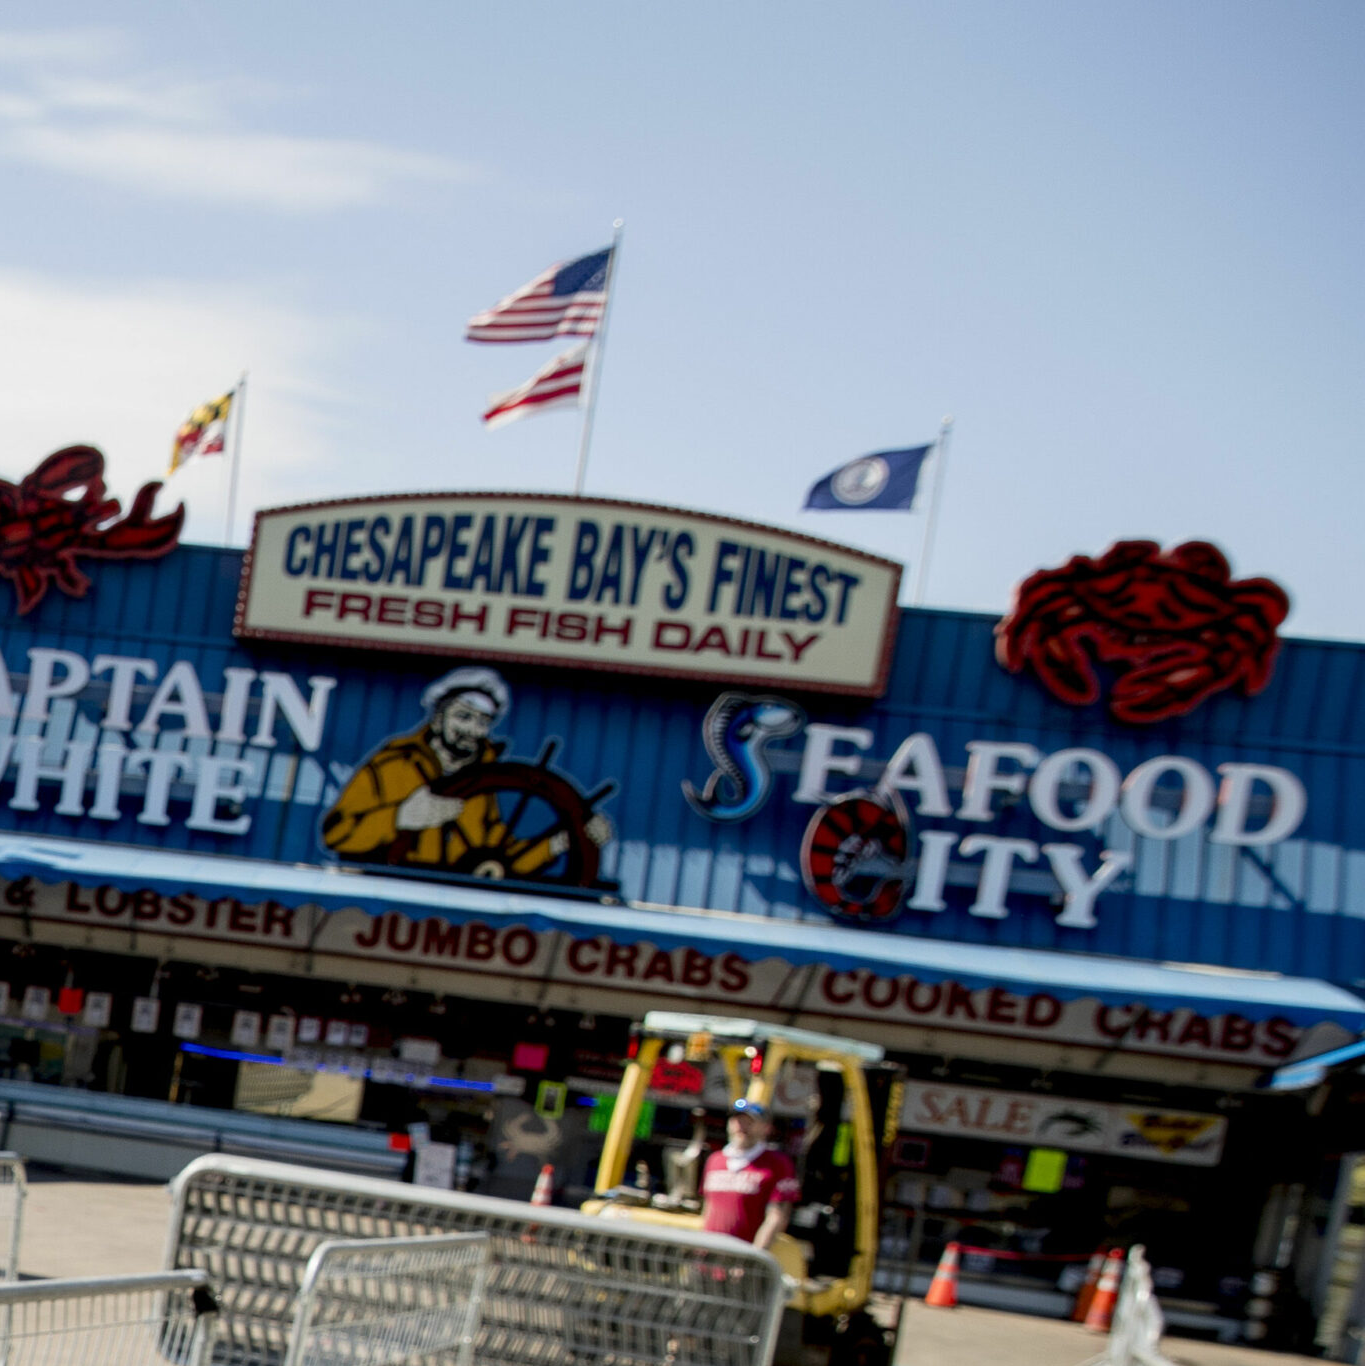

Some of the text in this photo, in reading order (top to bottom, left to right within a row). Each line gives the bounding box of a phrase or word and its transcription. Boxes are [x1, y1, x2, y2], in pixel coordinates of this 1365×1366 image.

[283, 511, 862, 628] CHESAPEAKE BAY'S FINEST
[302, 587, 822, 664] FRESH FISH DAILY
[4, 876, 36, 909] &
[66, 883, 295, 938] LOBSTER
[354, 912, 751, 993] JUMBO CRABS
[820, 966, 1300, 1058] COOKED CRABS
[914, 1087, 1033, 1136] SALE
